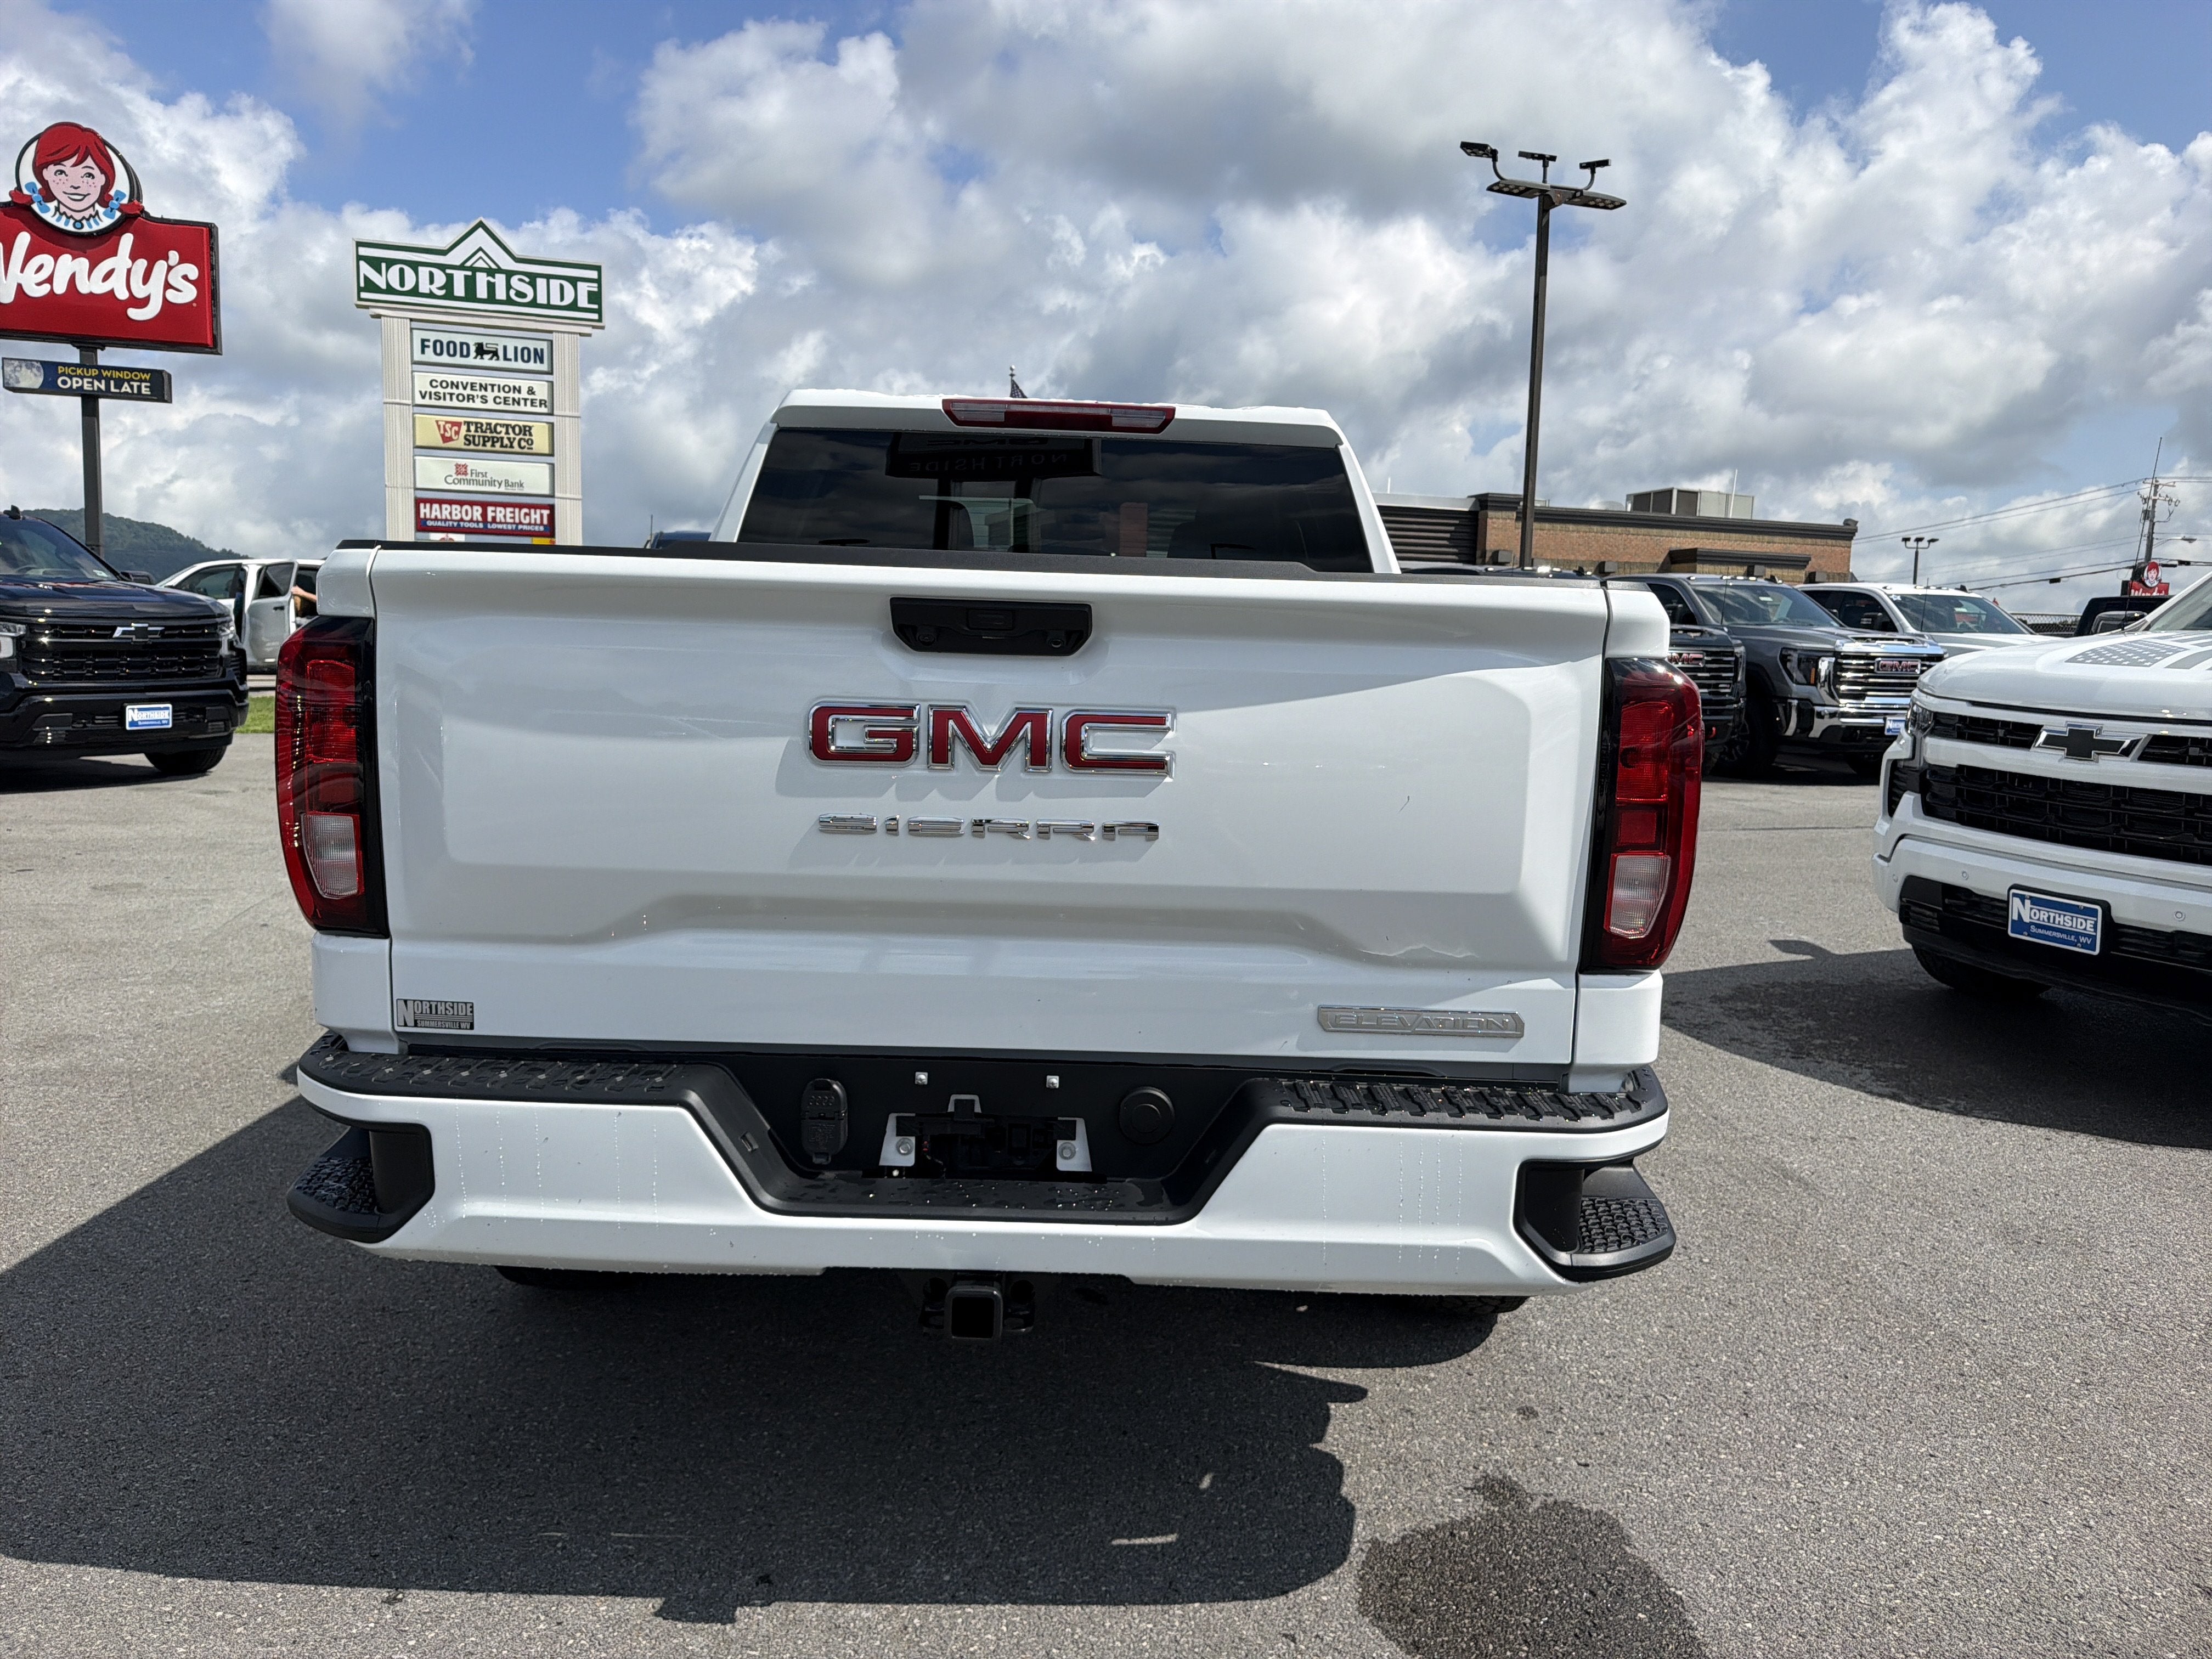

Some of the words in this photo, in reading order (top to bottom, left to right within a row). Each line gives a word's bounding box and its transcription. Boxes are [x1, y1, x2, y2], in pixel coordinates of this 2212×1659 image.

[359, 259, 599, 309] NORTHSIDE
[420, 338, 471, 358] FOOD
[503, 345, 545, 364] LION
[58, 366, 99, 377] PICKUP
[101, 369, 151, 381] WINDOW
[57, 376, 105, 391] OPEN
[110, 380, 151, 395] LATE
[429, 379, 522, 394] CONVENTION
[527, 386, 537, 396] &
[419, 390, 488, 404] VISITOR'S
[493, 396, 548, 408] CENTER
[438, 421, 459, 440] TSC
[463, 420, 534, 437] TRACTOR
[463, 434, 516, 449] SUPPLY
[444, 474, 503, 489] Community
[504, 478, 525, 489] Bank
[470, 469, 488, 478] First
[420, 503, 483, 521] HARBOR
[487, 506, 550, 525] FREIGHT
[1668, 652, 1703, 666] MC
[1878, 660, 1920, 673] GMC
[808, 701, 1175, 780] GMC
[817, 813, 1160, 841] SIERRA
[2012, 896, 2095, 932] NORTHSIDE
[2030, 925, 2077, 943] SUMMERSVILLE,
[2079, 935, 2092, 945] WV
[397, 1000, 473, 1027] NORTHSIDE
[1335, 1013, 1509, 1030] ELEVATION
[417, 1020, 459, 1029] SUMMERSVILLE
